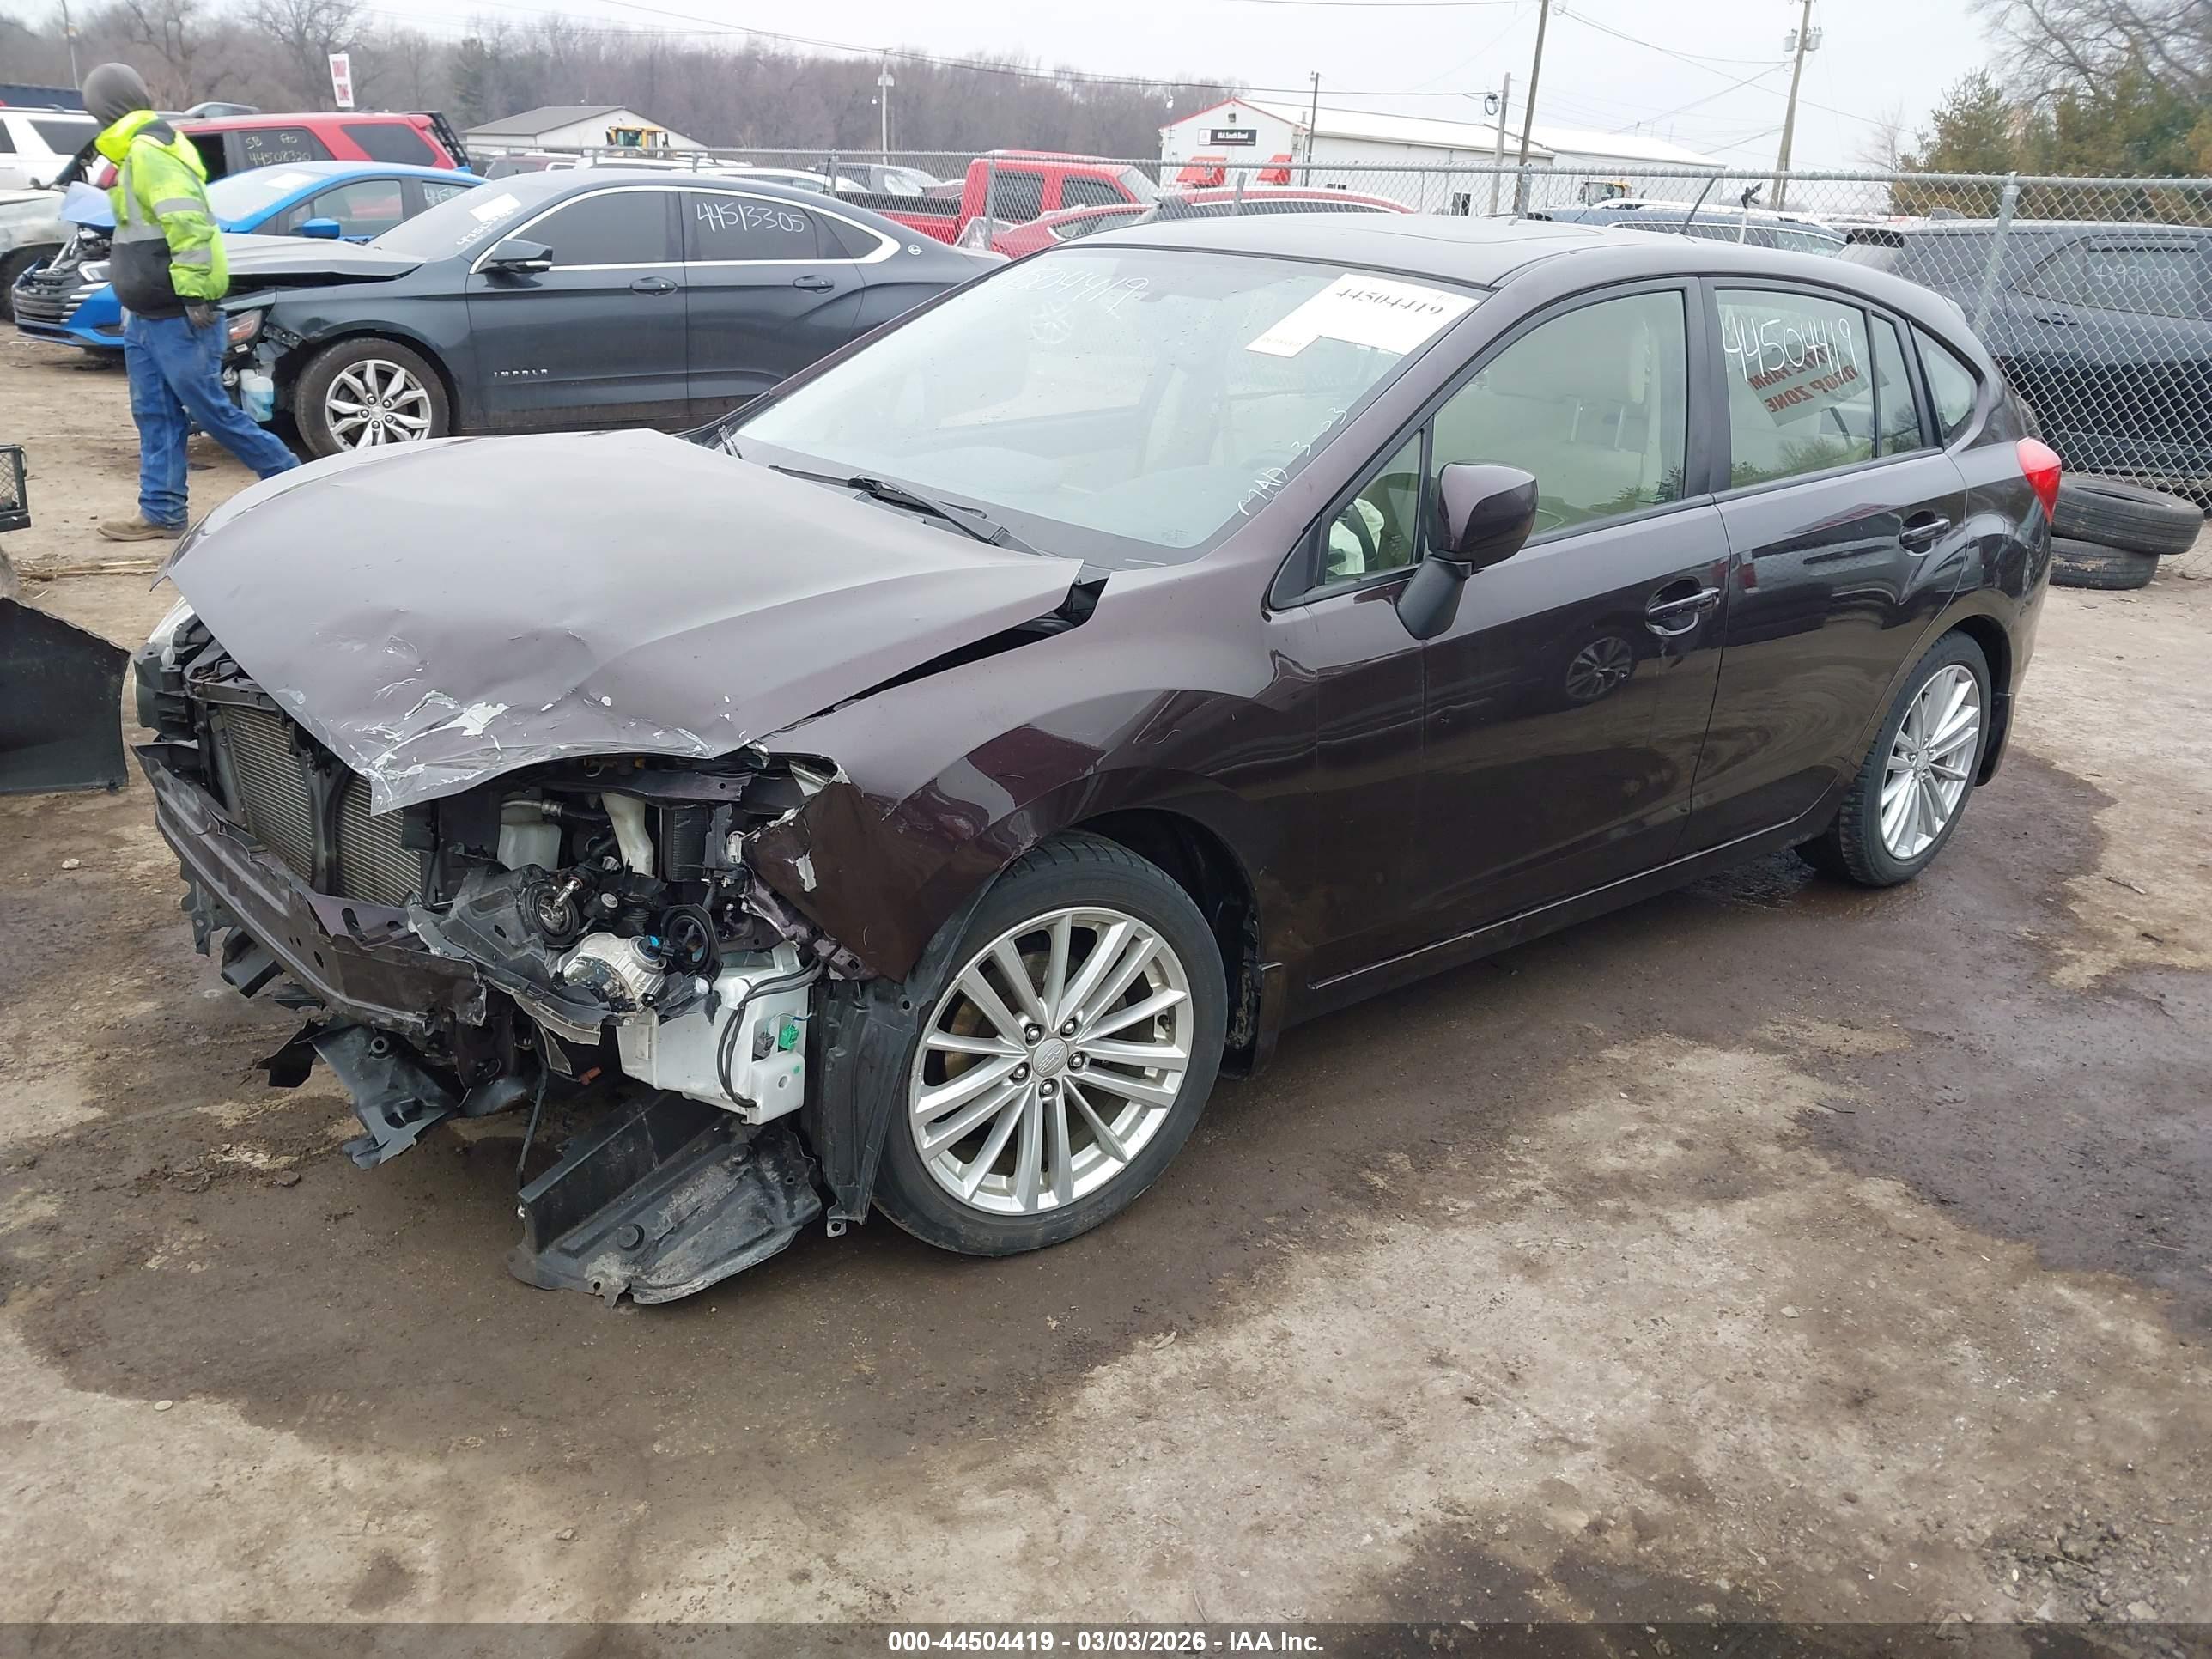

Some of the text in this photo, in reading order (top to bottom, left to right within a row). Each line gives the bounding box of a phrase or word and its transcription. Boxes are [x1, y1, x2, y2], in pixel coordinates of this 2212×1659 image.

[696, 201, 805, 233] 44513305
[1336, 288, 1444, 315] 44504419
[1721, 316, 1858, 383] 44504419
